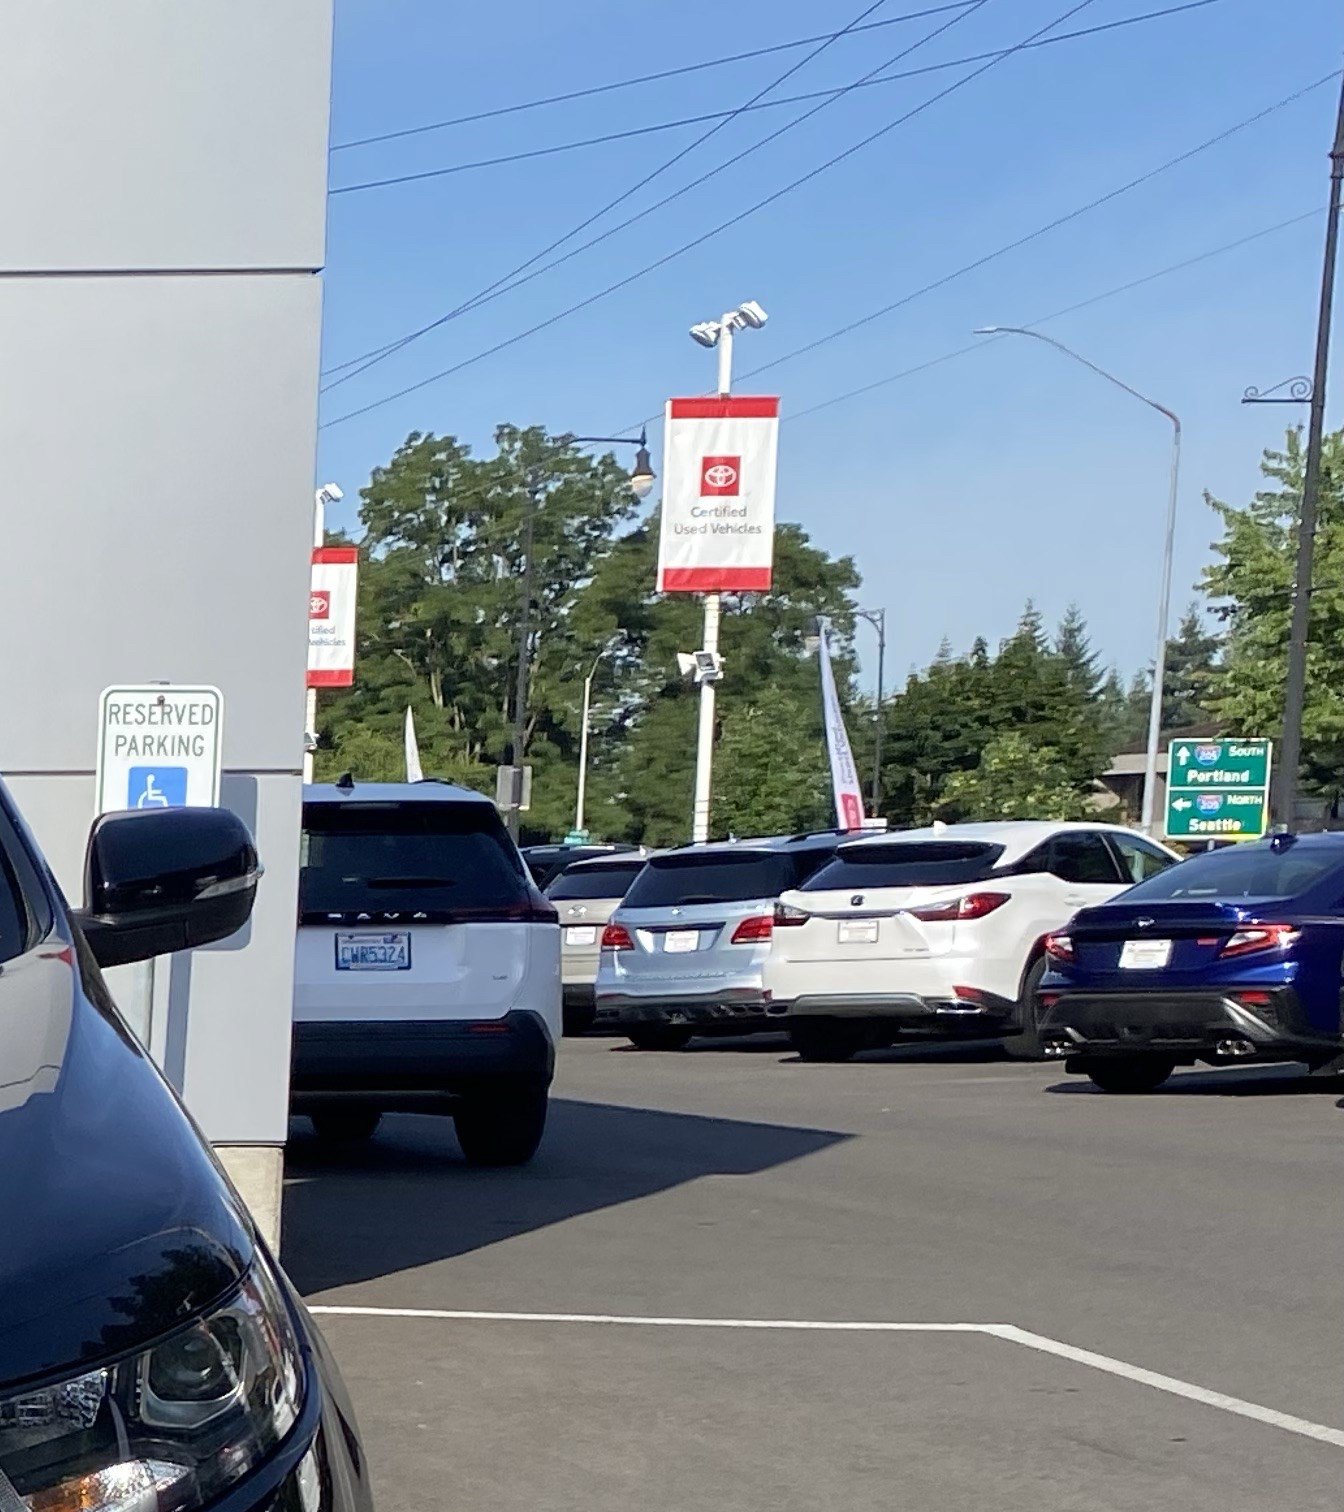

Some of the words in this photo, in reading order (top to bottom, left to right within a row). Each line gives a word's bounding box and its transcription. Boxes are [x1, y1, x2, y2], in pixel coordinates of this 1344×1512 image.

[691, 505, 747, 518] Certified
[674, 523, 707, 534] Used
[710, 523, 762, 534] Vehicles
[108, 703, 214, 726] RESERVED
[114, 734, 205, 757] PARKING
[1187, 769, 1250, 783] Portland
[1189, 818, 1242, 831] Seattle
